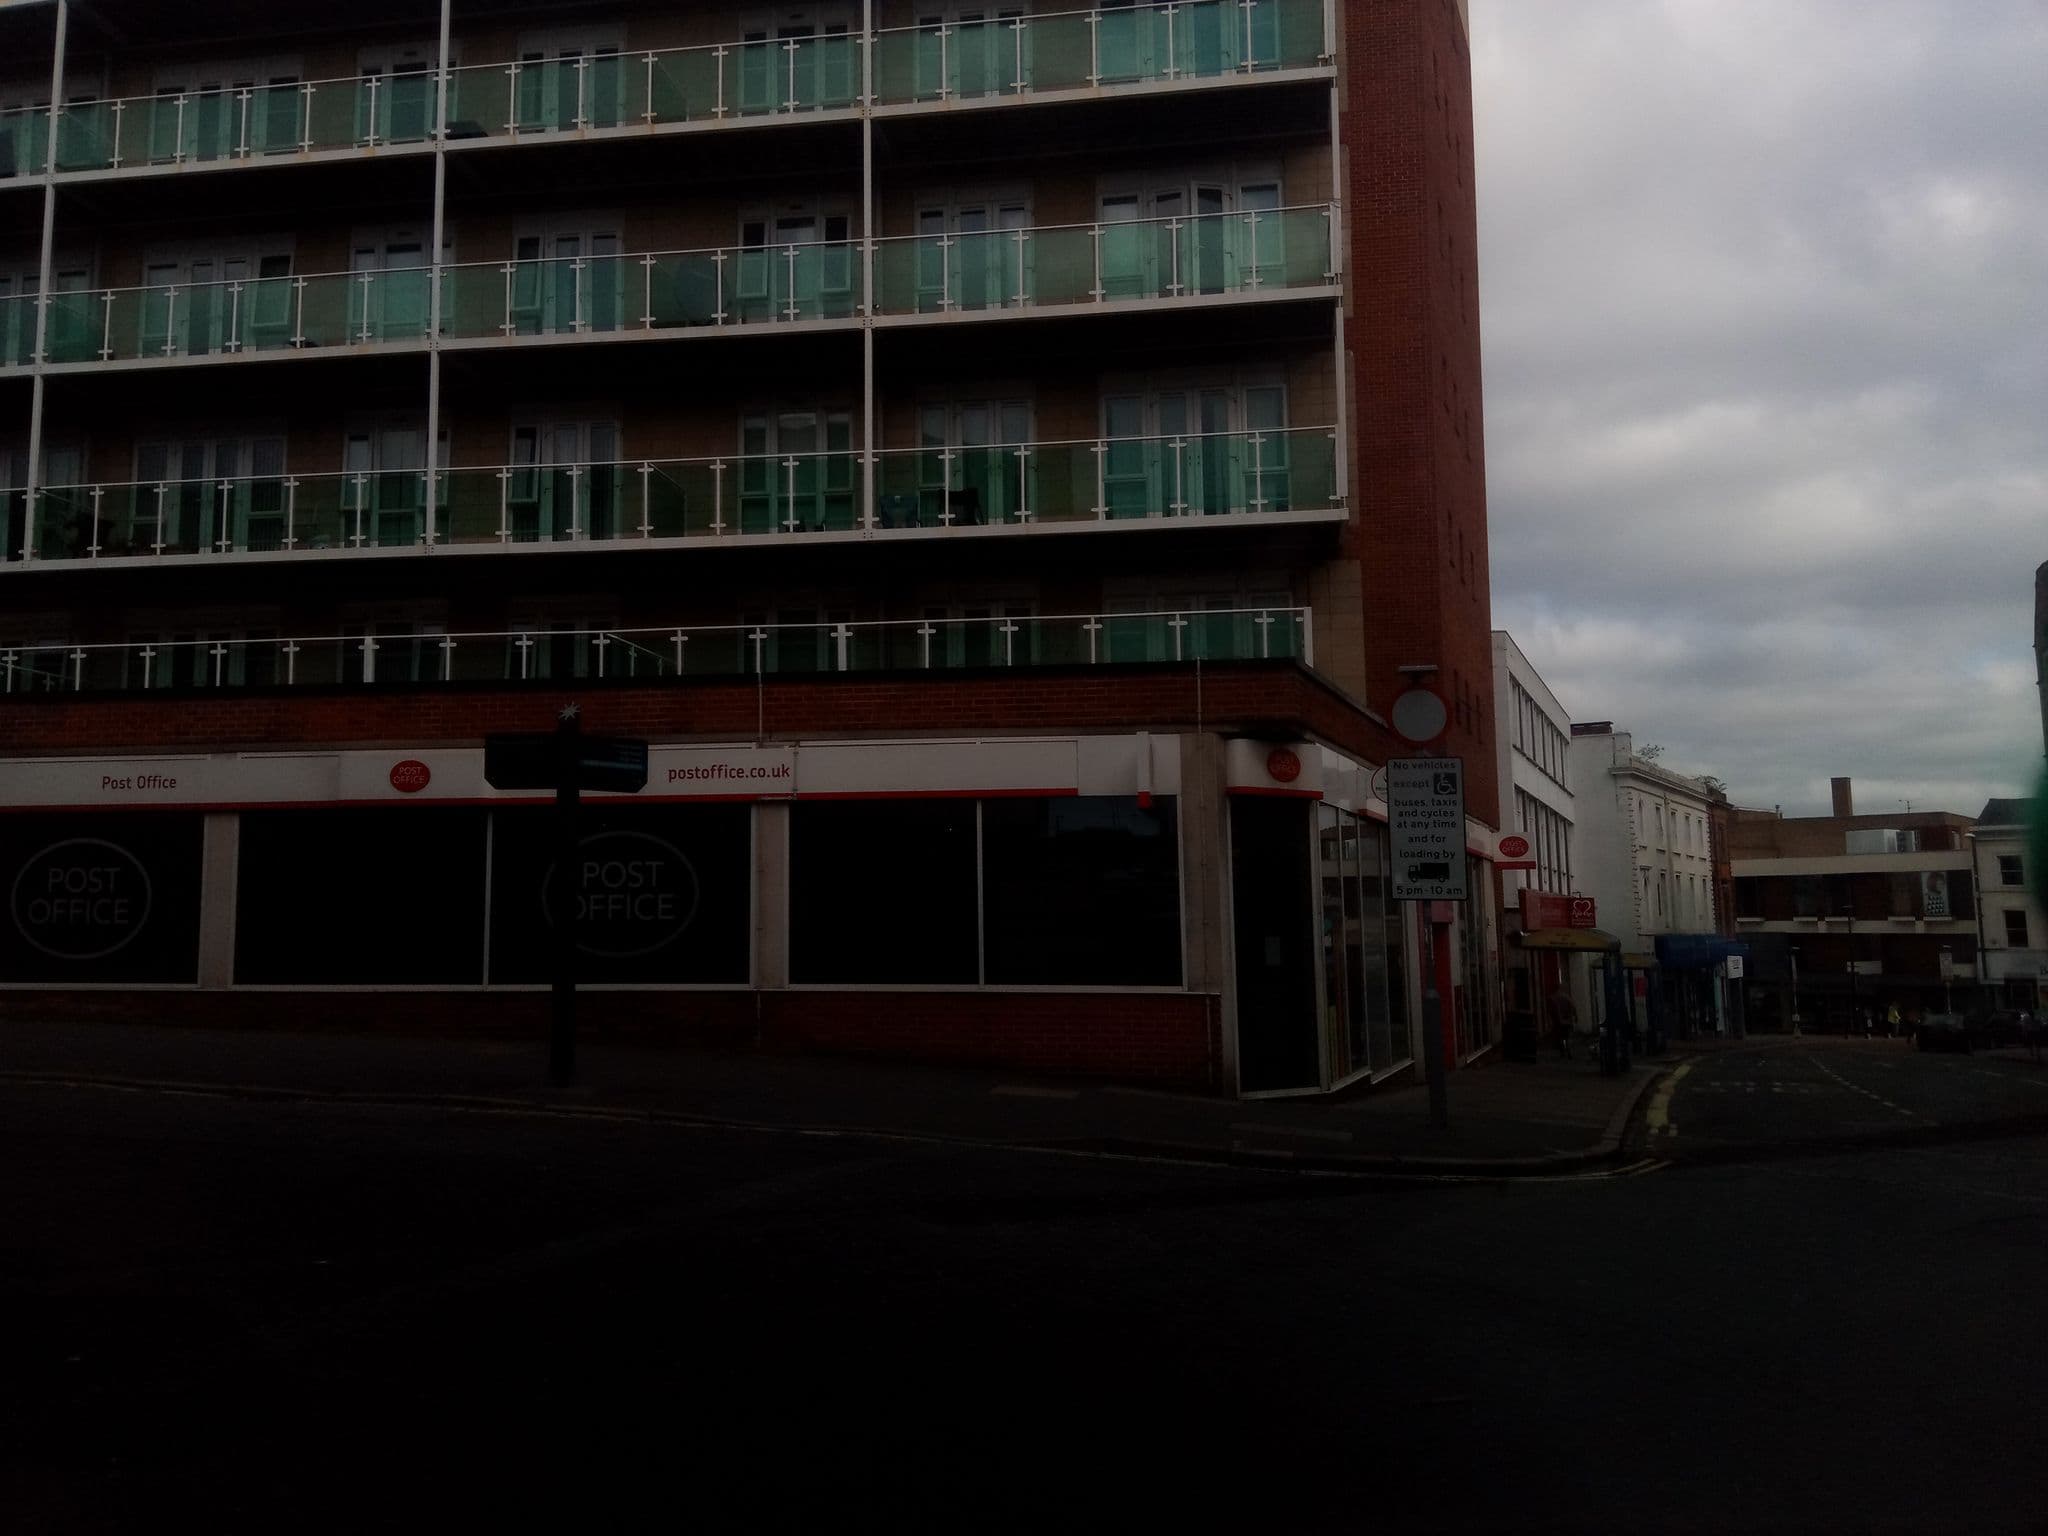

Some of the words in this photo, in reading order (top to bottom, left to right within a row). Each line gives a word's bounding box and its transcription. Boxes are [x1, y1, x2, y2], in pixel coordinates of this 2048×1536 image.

[1393, 761, 1408, 770] No
[1411, 760, 1456, 770] vehicles
[399, 766, 422, 775] POST
[668, 763, 790, 783] postoffice.co.uk
[102, 776, 132, 790] Post
[137, 775, 177, 789] Office
[393, 775, 425, 784] OFFICE
[1393, 779, 1429, 789] except
[1394, 799, 1428, 807] buses,
[1431, 798, 1457, 807] taxis
[1398, 809, 1418, 817] and
[1421, 809, 1455, 819] cycles
[1396, 820, 1407, 828] at
[1411, 821, 1429, 830] any
[1433, 820, 1457, 828] time
[1408, 835, 1428, 843] and
[1431, 834, 1446, 843] for
[1399, 850, 1440, 860] loading
[1442, 850, 1456, 859] by
[583, 860, 664, 888] POST
[47, 867, 120, 894] POST
[1396, 886, 1403, 894] 5
[28, 897, 129, 925] OFFICE
